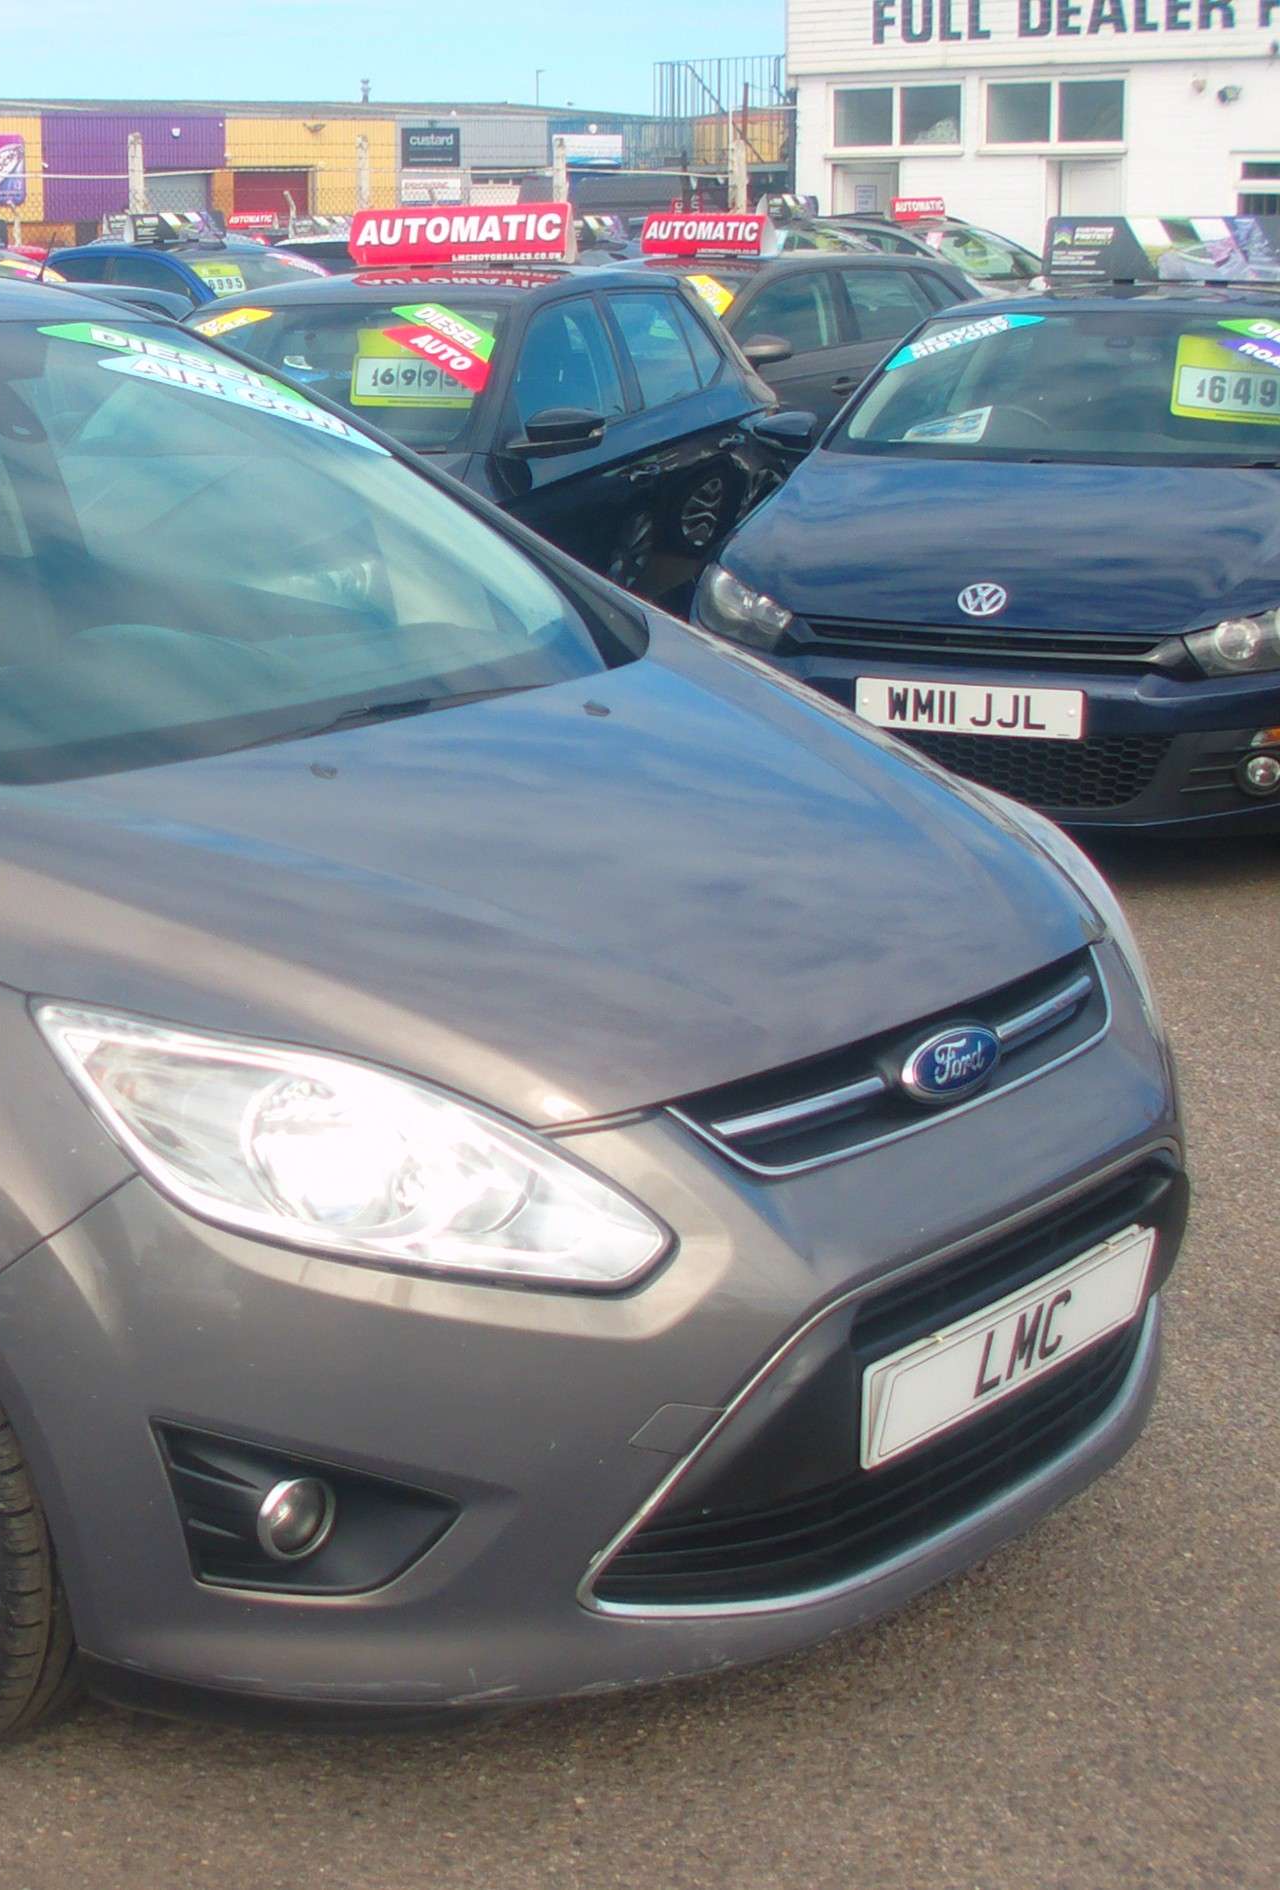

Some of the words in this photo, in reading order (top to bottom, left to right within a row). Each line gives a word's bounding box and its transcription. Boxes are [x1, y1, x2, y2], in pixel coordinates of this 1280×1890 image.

[872, 0, 991, 45] FULL
[1017, 0, 1235, 38] DEALER
[409, 132, 454, 146] custard
[228, 213, 274, 225] AUTOMATIC
[894, 199, 946, 214] AUTOMATIC
[356, 213, 563, 247] AUTOMATIC
[645, 219, 760, 242] AUTOMATIC
[414, 305, 483, 350] DIESEL
[1248, 322, 1280, 346] DI
[88, 325, 278, 396] DIESEL
[409, 333, 473, 371] AUTO
[131, 355, 227, 397] AIR
[234, 385, 352, 437] CON
[887, 686, 957, 725] WM11
[969, 692, 1047, 731] JJL
[934, 1037, 985, 1085] Ford
[973, 1288, 1072, 1399] LMC
